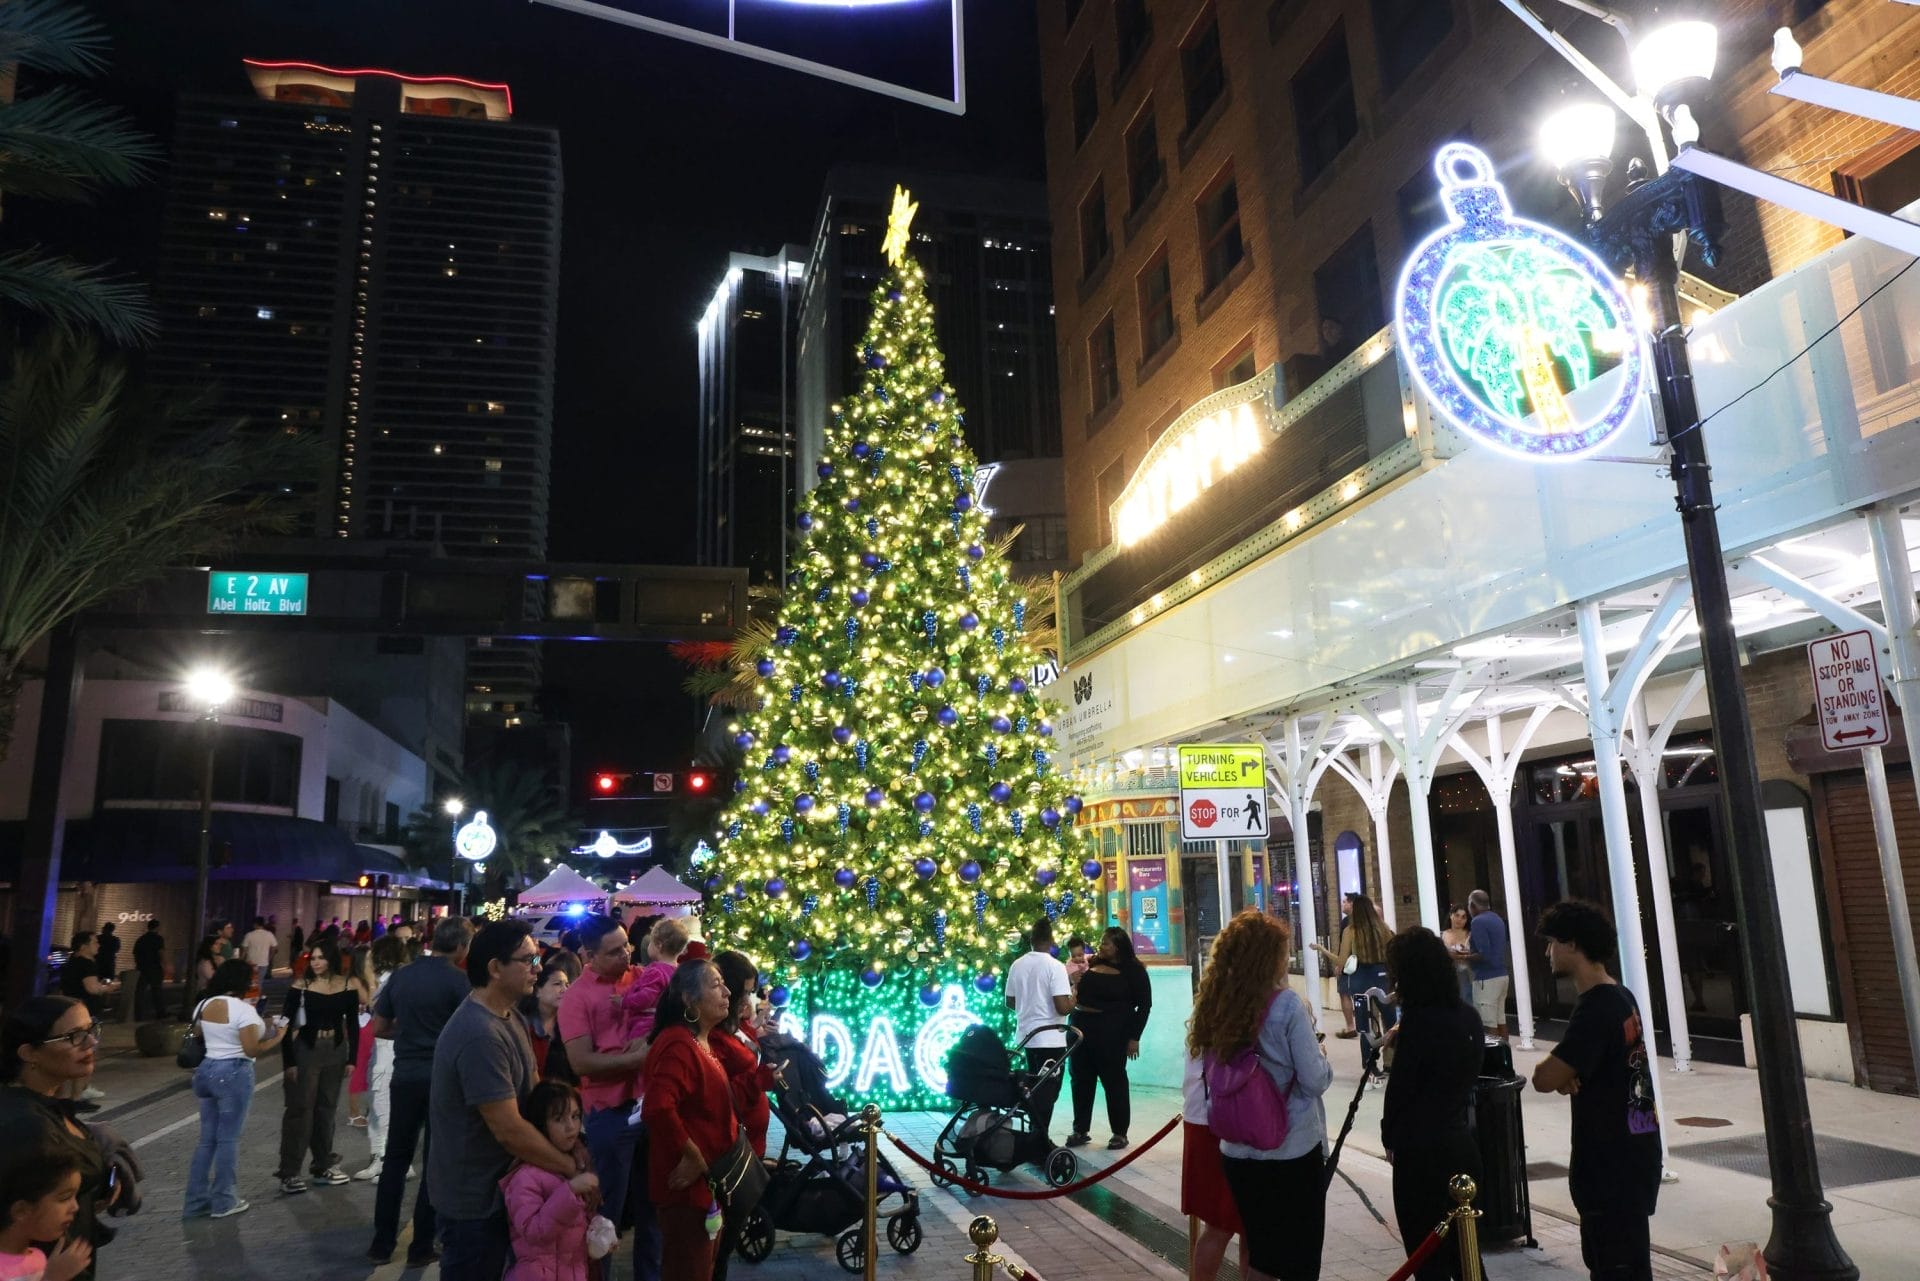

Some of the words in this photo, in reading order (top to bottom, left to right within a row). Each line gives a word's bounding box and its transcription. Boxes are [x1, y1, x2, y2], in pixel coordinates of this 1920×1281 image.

[227, 577, 237, 594] E
[246, 575, 259, 597] 2
[268, 578, 289, 595] AV
[212, 597, 236, 611] Abel
[244, 598, 271, 612] Holtz
[279, 598, 302, 612] Blvd
[1830, 639, 1851, 662] NO
[1819, 657, 1871, 681] STOPPING
[1838, 677, 1855, 693] OR
[1823, 689, 1876, 712] STANDING
[1079, 699, 1112, 722] UMBRELLA
[1825, 716, 1838, 725] TOW
[1843, 712, 1860, 723] AWAY
[1863, 709, 1881, 720] ZONE
[1186, 753, 1235, 765] TURNING
[1186, 771, 1238, 782] VEHICLES
[1191, 807, 1216, 819] STOP
[1221, 807, 1240, 819] FOR
